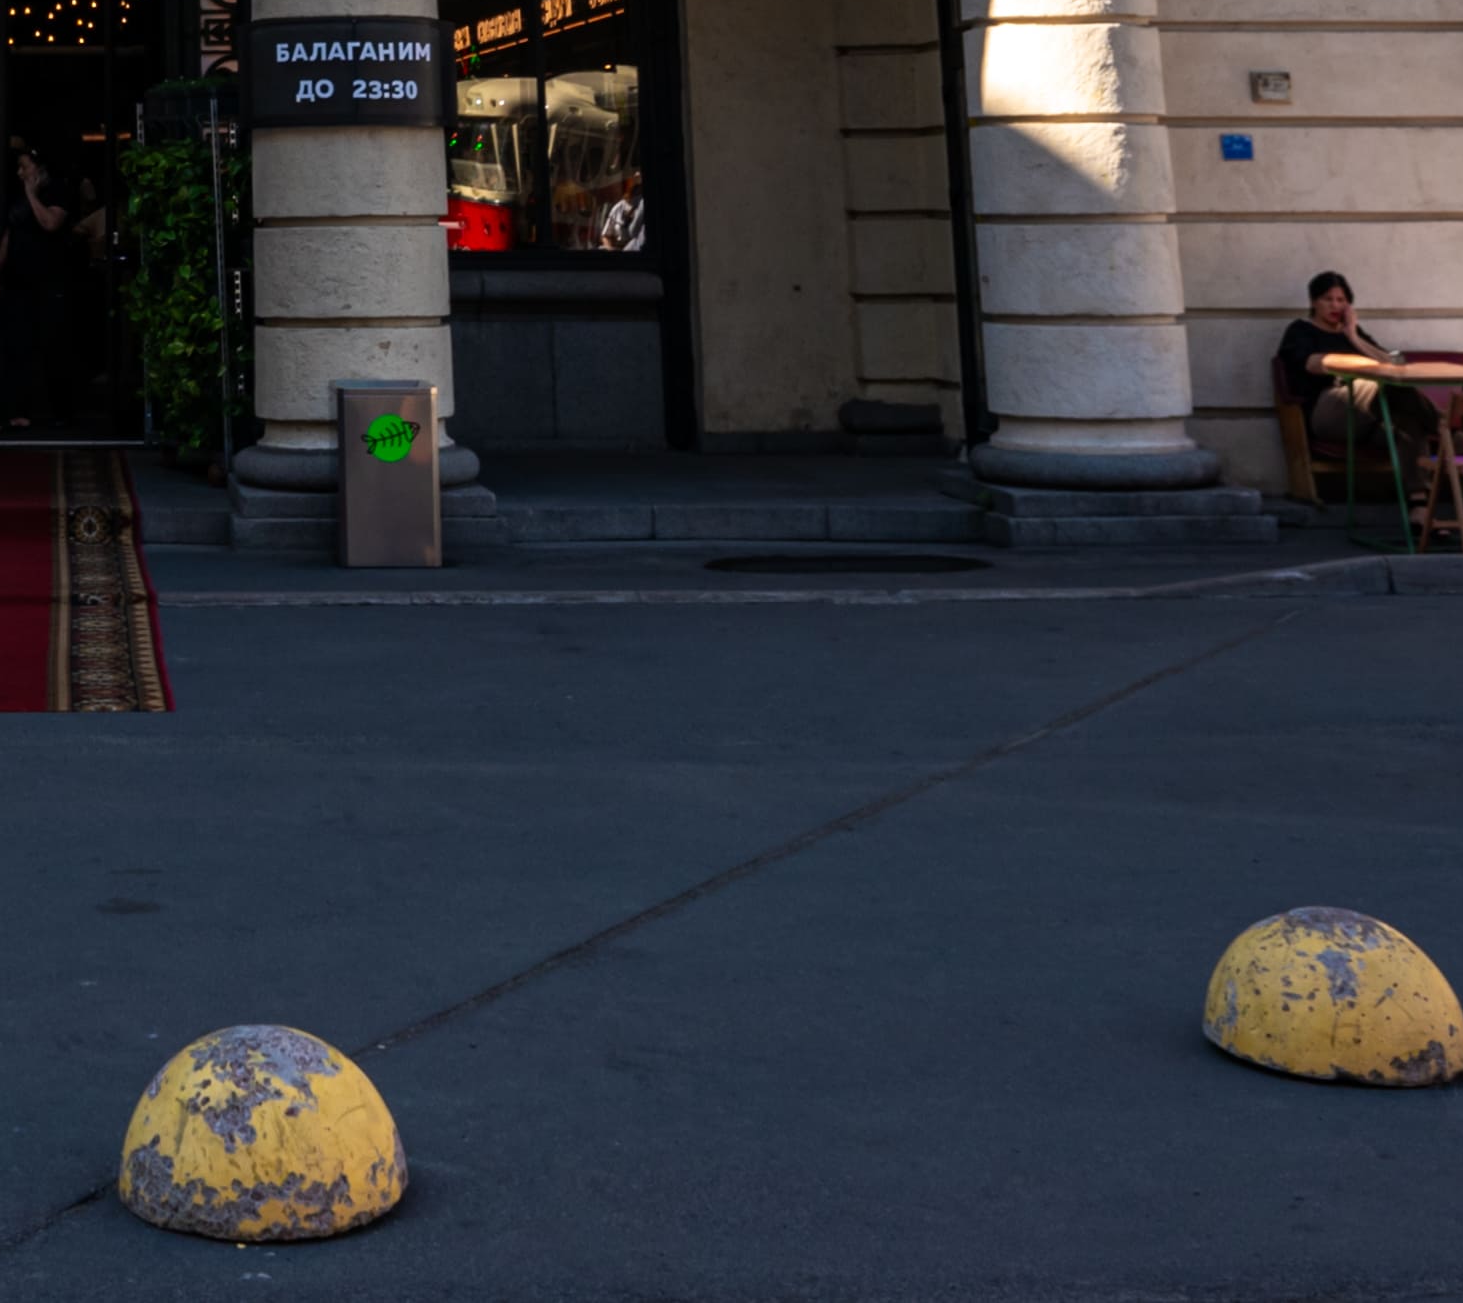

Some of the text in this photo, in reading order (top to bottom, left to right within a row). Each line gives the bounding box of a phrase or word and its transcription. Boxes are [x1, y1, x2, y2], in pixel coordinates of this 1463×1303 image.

[275, 41, 432, 63] БАЛАГАНИМ
[295, 79, 418, 103] ДО 23:30
